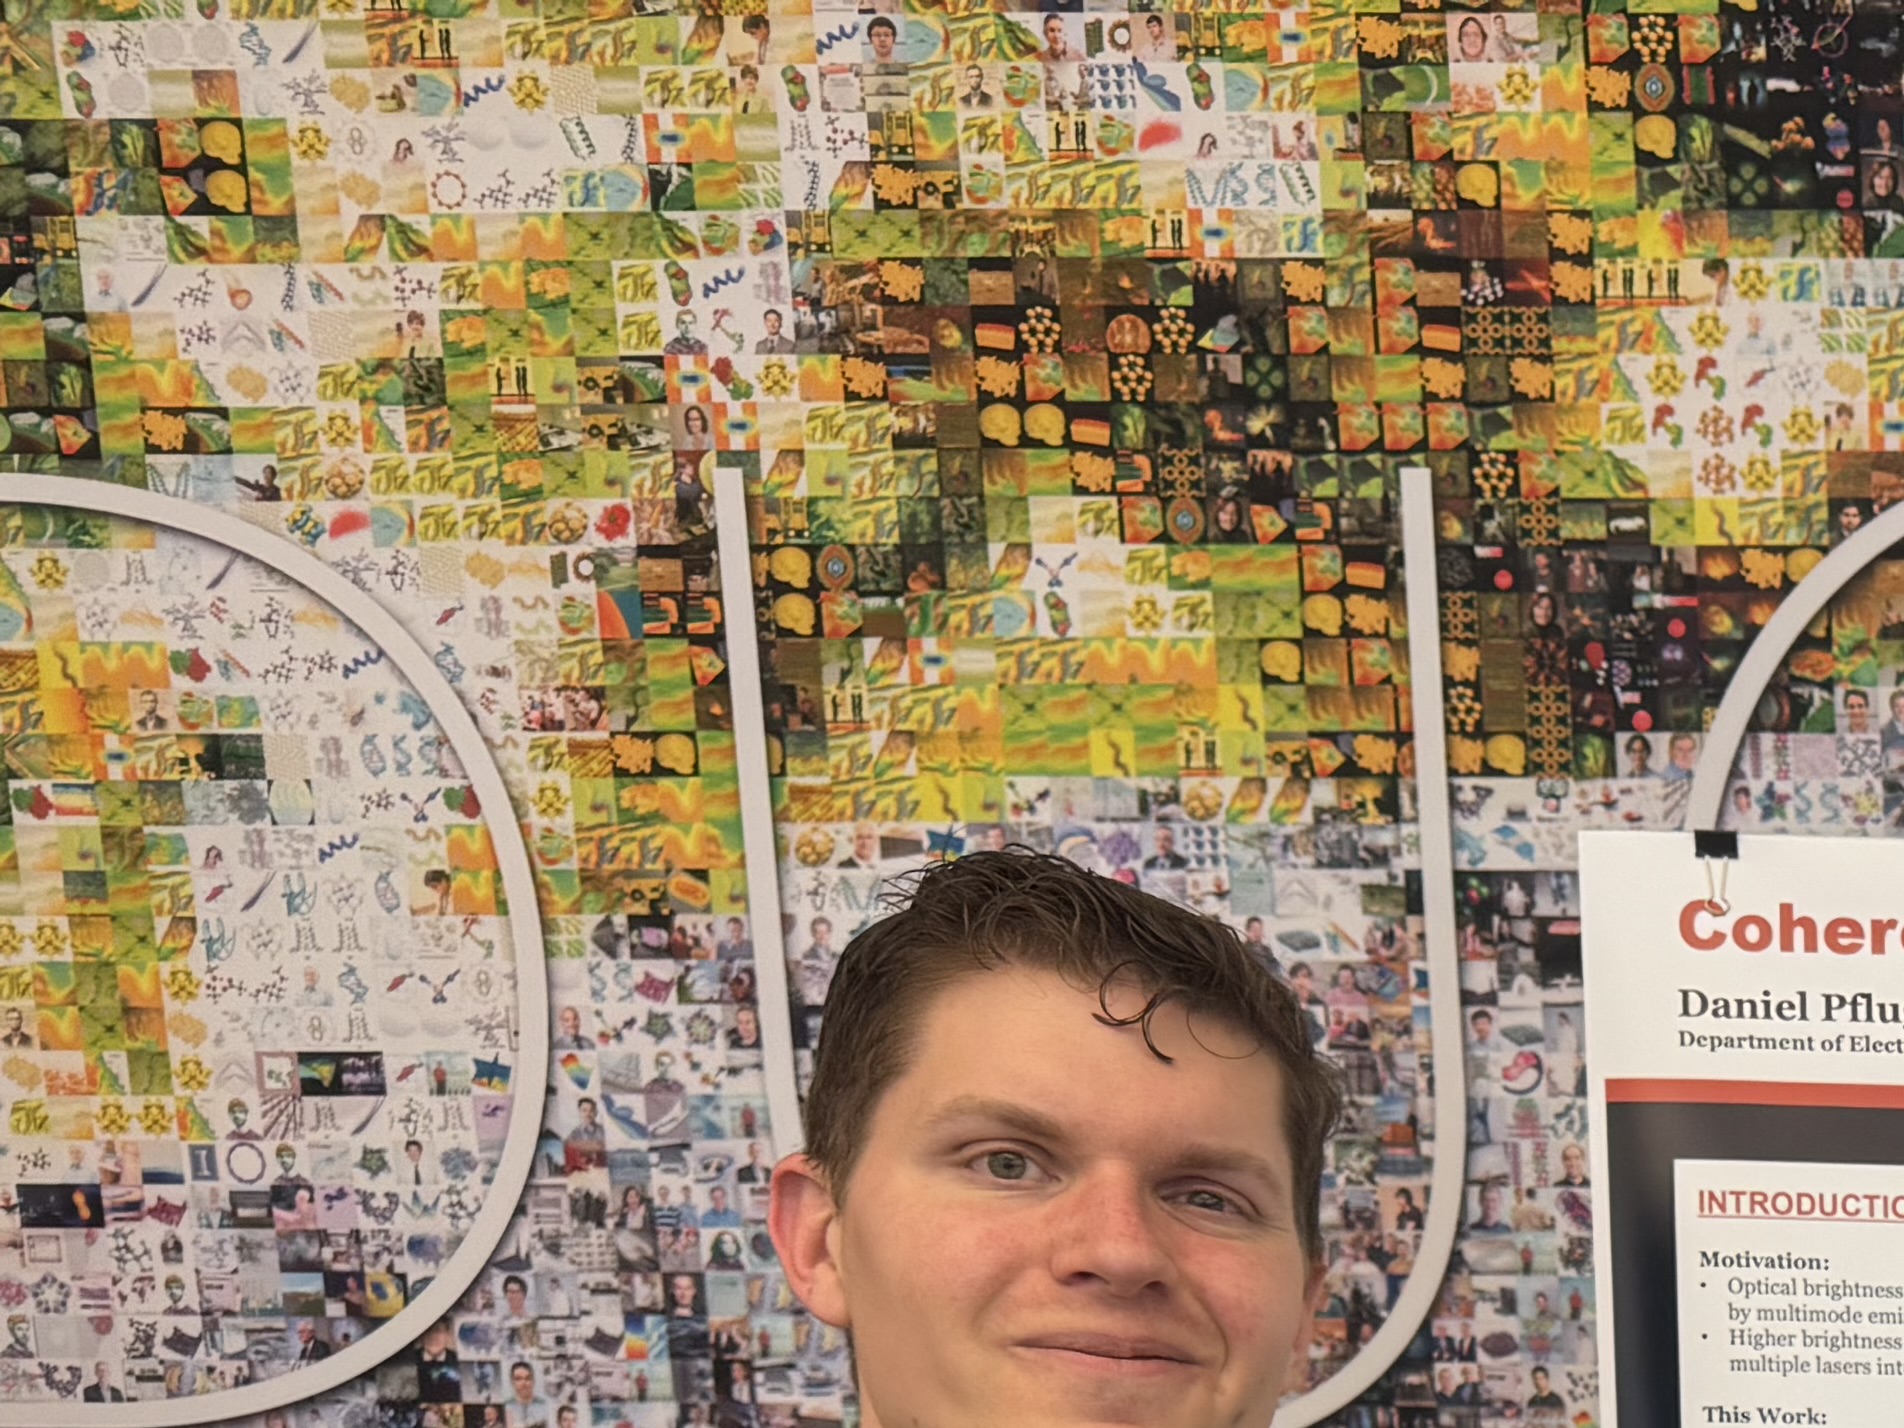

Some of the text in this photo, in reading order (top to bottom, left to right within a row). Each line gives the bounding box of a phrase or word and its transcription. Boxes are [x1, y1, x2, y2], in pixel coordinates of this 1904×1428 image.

[1678, 989, 1810, 1023] Daniel
[1678, 1029, 1815, 1053] Department
[1820, 1033, 1846, 1053] of
[1699, 1249, 1830, 1272] Motivation:
[1727, 1275, 1798, 1301] Optical
[1803, 1276, 1904, 1302] brightness
[1728, 1302, 1752, 1327] by
[1756, 1303, 1864, 1325] multimode
[1701, 1404, 1827, 1427] This Work:
